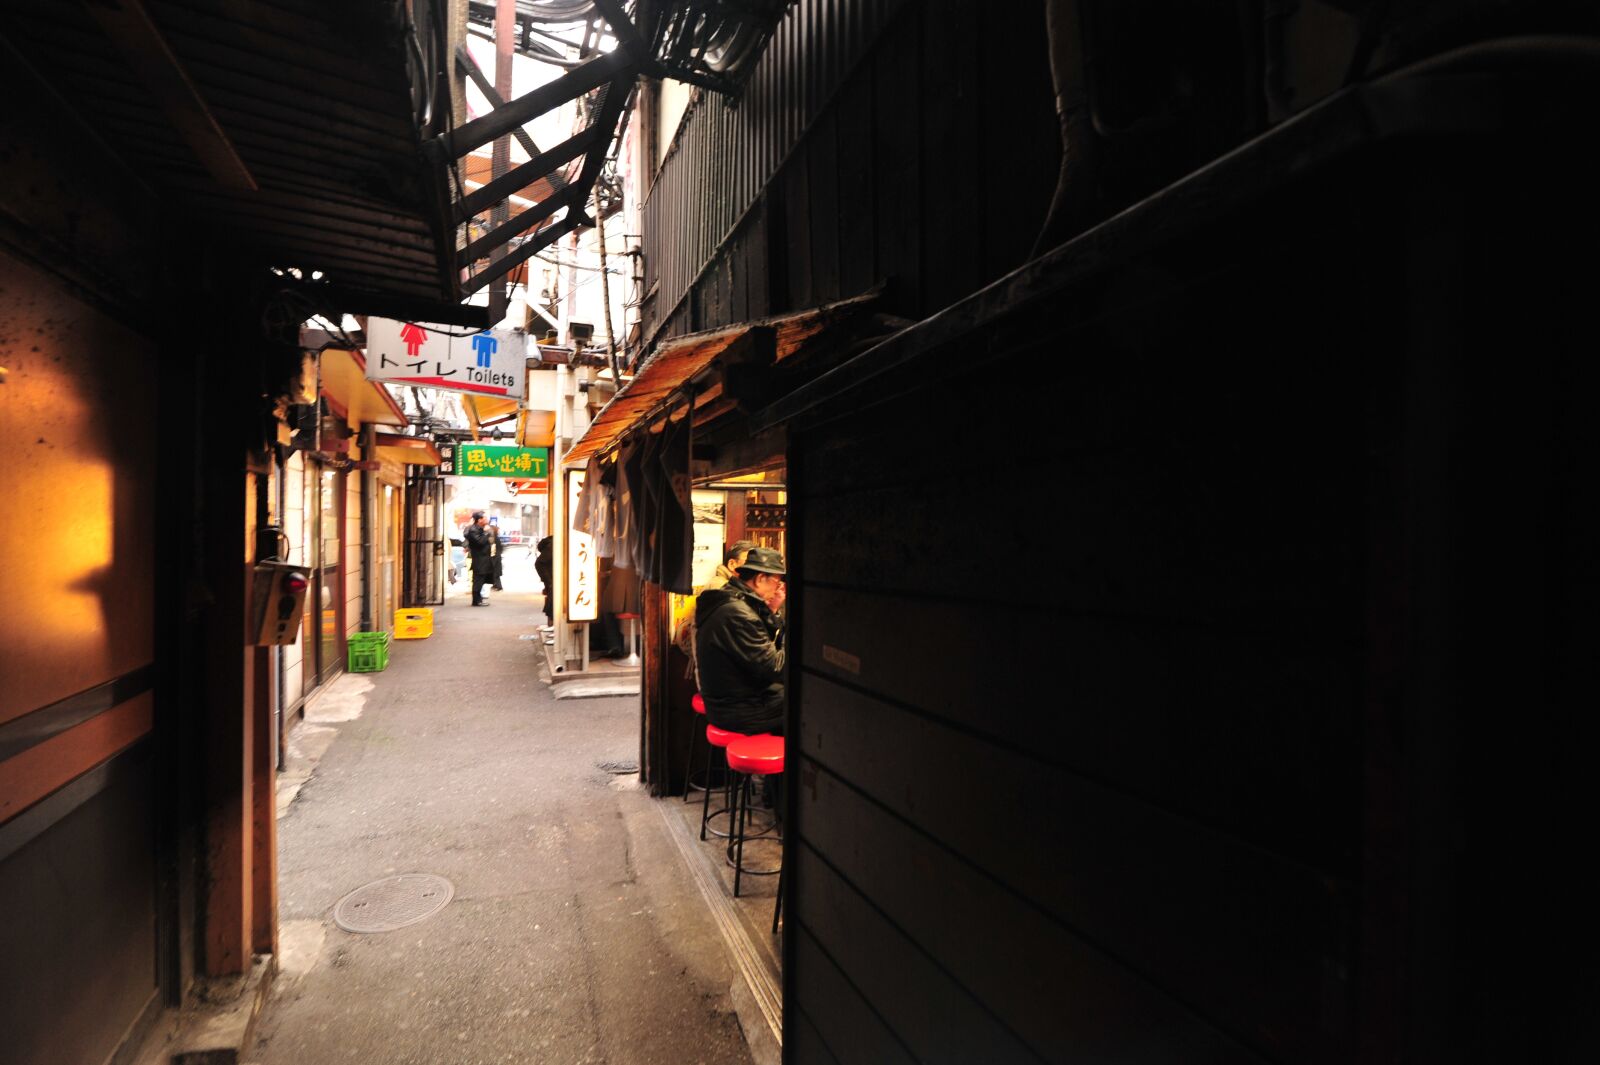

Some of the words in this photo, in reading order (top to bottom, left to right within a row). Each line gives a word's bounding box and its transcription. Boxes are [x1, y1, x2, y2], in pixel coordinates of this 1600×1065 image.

[380, 353, 457, 376] トイレ
[466, 366, 515, 387] Toilets
[467, 449, 545, 474] 思い出横丁
